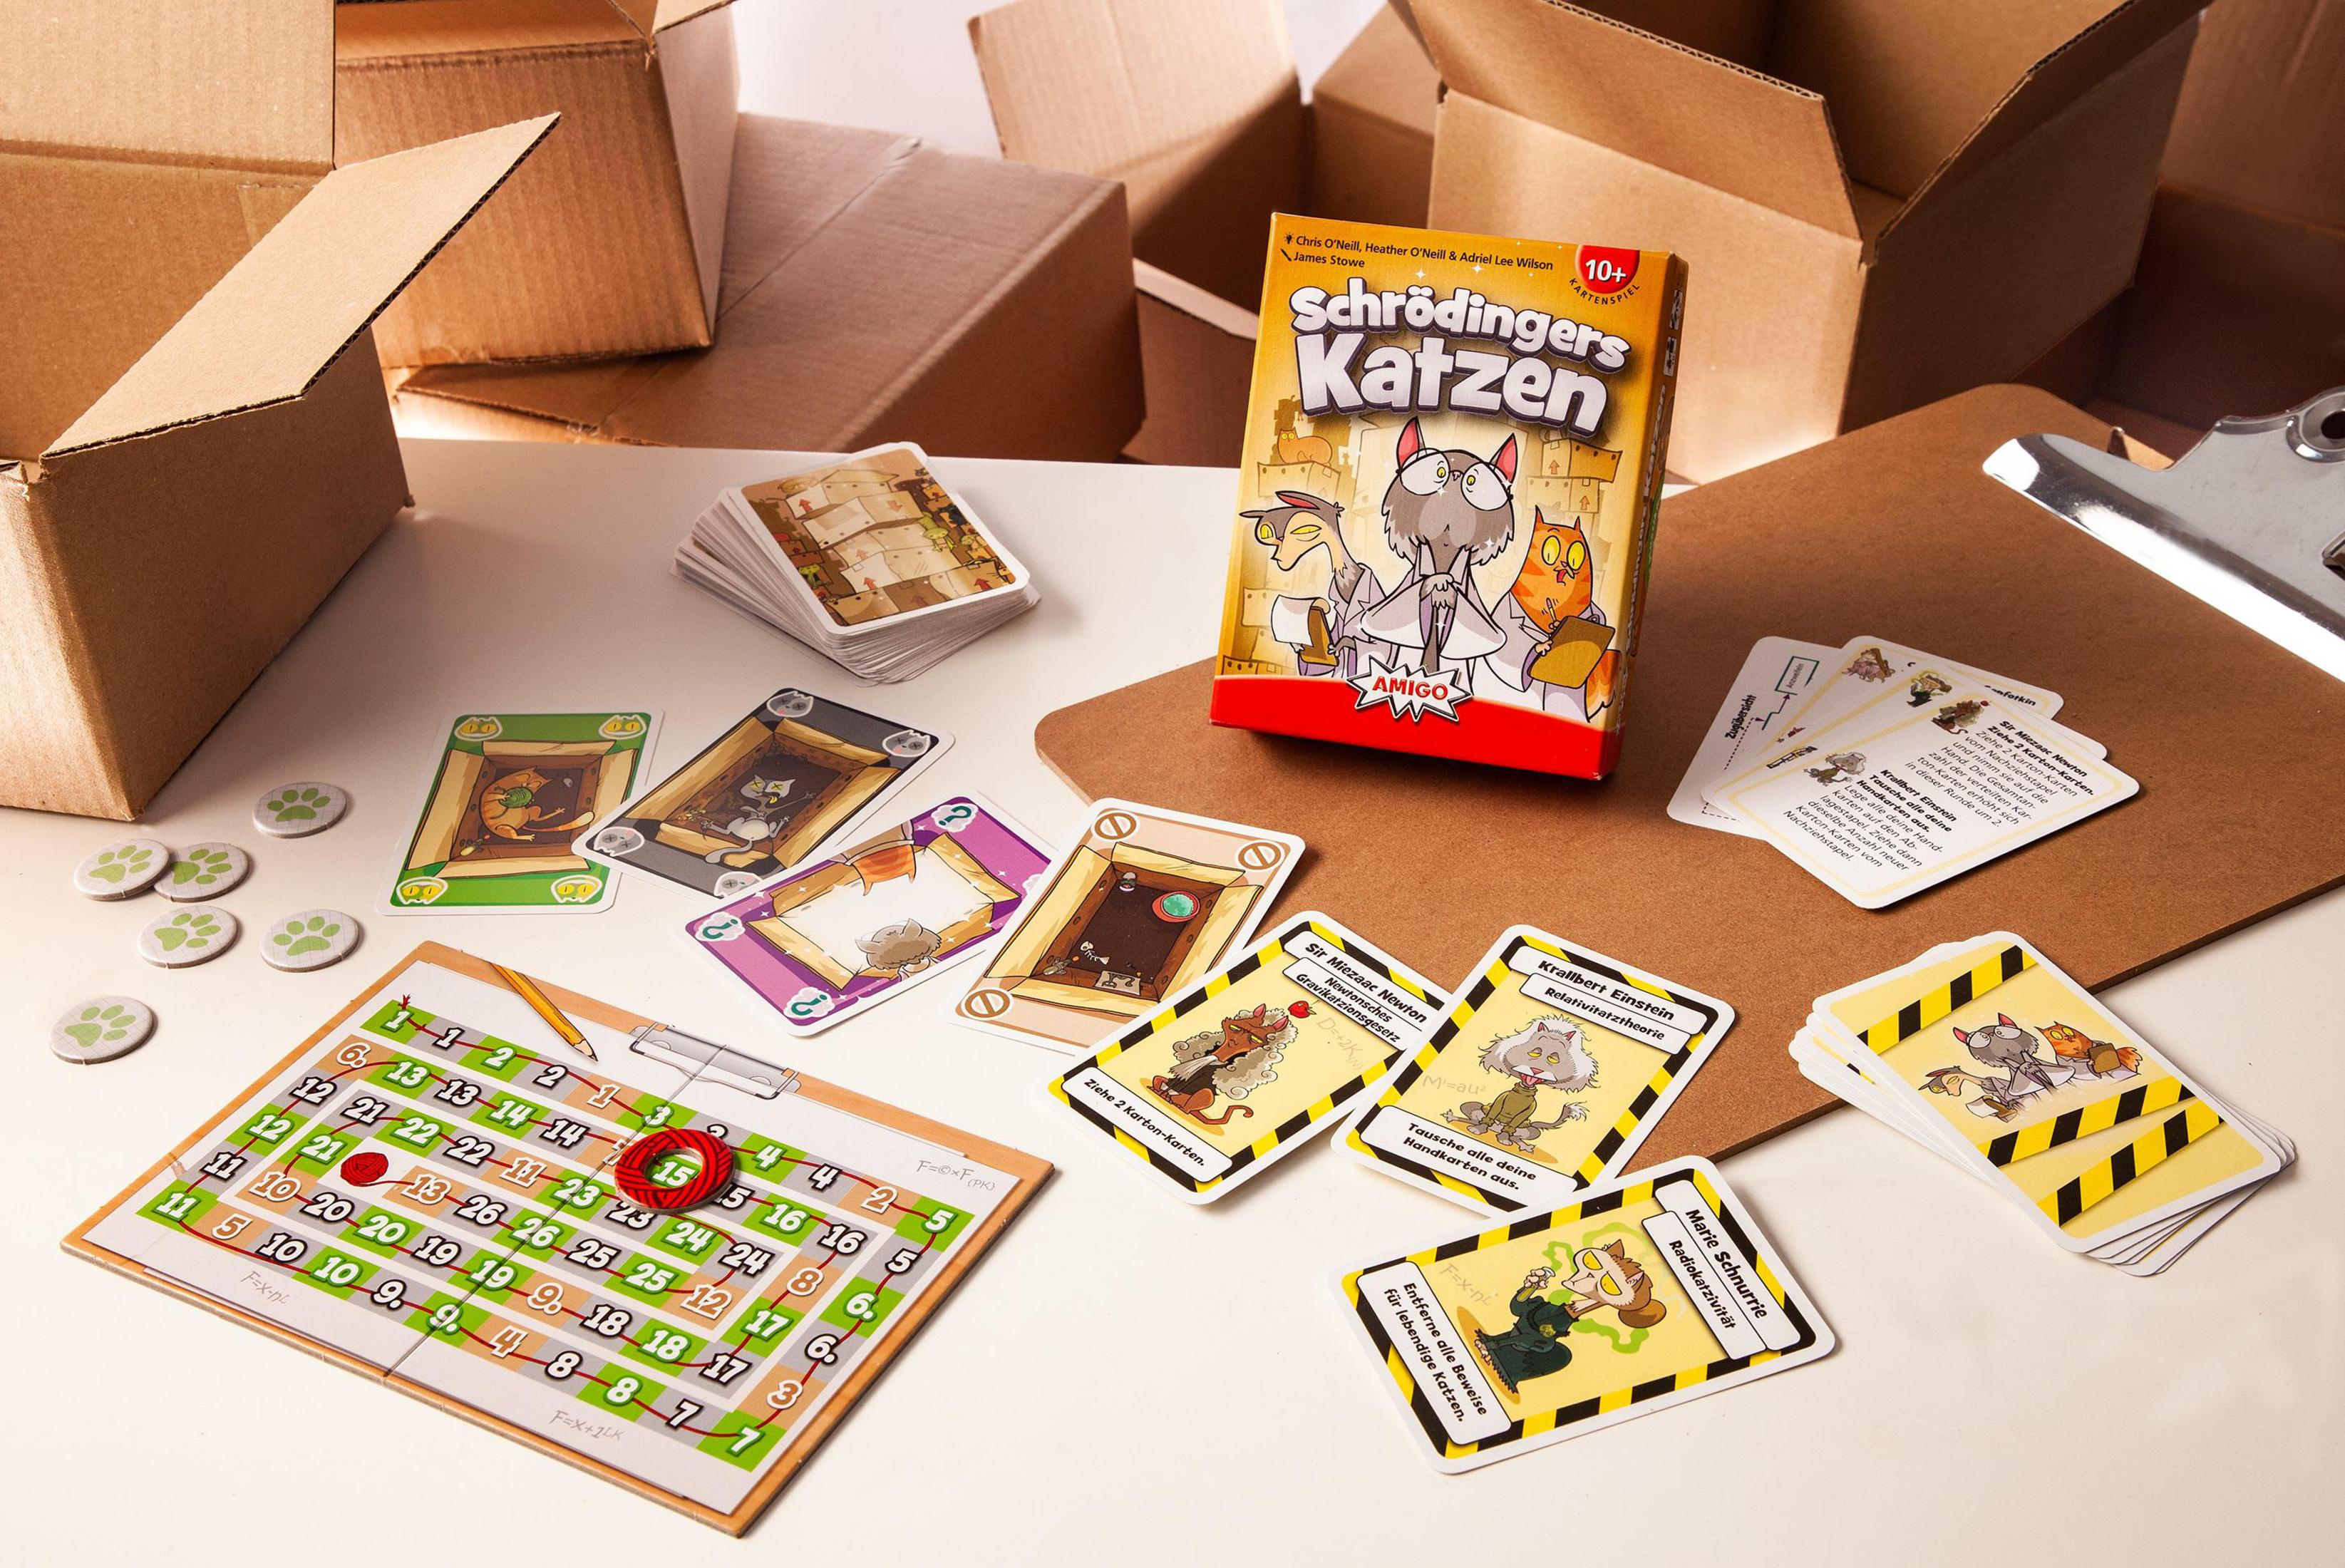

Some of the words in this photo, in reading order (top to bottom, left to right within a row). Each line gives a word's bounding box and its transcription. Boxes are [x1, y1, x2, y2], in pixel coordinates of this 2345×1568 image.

[1294, 252, 1326, 264] James
[1330, 255, 1365, 267] Stowe
[1296, 236, 1321, 247] Chris
[1366, 243, 1408, 256] Heather
[1449, 251, 1457, 261] &
[1459, 252, 1492, 264] Adriel
[1495, 255, 1513, 266] Lee
[1516, 258, 1553, 270] Wilson
[1585, 259, 1627, 283] 10+
[1569, 277, 1640, 304] KARTENSPIEL
[1289, 277, 1632, 375] Schrödingers
[1295, 333, 1609, 438] Katzen
[1372, 676, 1448, 701] AMIGO
[1724, 694, 1757, 739] Zugübersicht
[1941, 747, 1966, 765] Hand.
[1969, 765, 1986, 778] Die
[1987, 776, 2036, 810] Gesamtan-
[1953, 741, 1972, 755] und
[1974, 753, 1997, 769] nimm
[1998, 771, 2014, 783] sie
[2014, 780, 2031, 794] auf
[2031, 791, 2048, 805] die
[1965, 736, 1985, 749] vom
[1986, 751, 2057, 796] Nachziehstapel
[1976, 731, 2003, 748] Ziehe
[2011, 753, 2078, 797] Karton-Karten
[1988, 726, 2014, 743] Ziehe
[2022, 748, 2094, 795] Karton-Karten.
[1999, 721, 2016, 731] Sir
[2016, 729, 2052, 755] Miezaac
[2053, 754, 2087, 777] Newton
[1857, 780, 1911, 818] Handkarten
[1911, 817, 1930, 832] aus.
[1869, 775, 1906, 801] Tausche
[1906, 800, 1924, 815] alle
[1924, 813, 1952, 832] deine
[1880, 770, 1920, 797] Krallbert
[1919, 796, 1957, 822] Einstein
[1915, 768, 1944, 788] dieser
[1944, 788, 1974, 810] Runde
[1975, 808, 1991, 820] um
[1917, 757, 1967, 791] ton-Karten
[1967, 790, 1996, 813] erhöht
[1998, 811, 2019, 825] sich
[1928, 752, 1949, 767] zahl
[1949, 765, 1967, 778] der
[1967, 777, 2012, 808] verteilten
[2011, 806, 2032, 820] Kar-
[1783, 810, 1855, 862] Nachziehstapel.
[1795, 805, 1861, 852] Karton-Karten
[1861, 852, 1882, 867] vom
[1808, 800, 1846, 827] dieselbe
[1846, 827, 1881, 852] Anzahl
[1880, 850, 1910, 871] neuer
[1820, 795, 1867, 830] lagestapel.
[1869, 830, 1896, 850] Ziehe
[1897, 847, 1922, 867] dann
[1833, 790, 1863, 812] karten
[1863, 811, 1881, 824] auf
[1881, 824, 1900, 837] den
[1900, 837, 1918, 850] Ab-
[1845, 785, 1867, 802] Lege
[1867, 801, 1886, 815] alle
[1886, 813, 1913, 833] deine
[1913, 832, 1942, 853] Hand-
[1297, 974, 1401, 1042] Gravikatzionsgesetz
[1305, 943, 1327, 957] Sir
[1326, 956, 1378, 992] Miezaac
[1378, 989, 1428, 1023] Newton
[1325, 977, 1393, 1022] Newtonsches
[1537, 961, 1607, 994] Krallbert
[1610, 989, 1674, 1021] Einstein
[1545, 987, 1665, 1041] Relativitatztheorie
[383, 1010, 412, 1031] 1
[433, 1028, 463, 1048] 1
[482, 1046, 515, 1068] 2
[534, 1066, 567, 1088] 2
[588, 1085, 619, 1108] 1
[644, 1105, 672, 1127] 3
[755, 1144, 785, 1170] 4
[810, 1165, 840, 1190] 4
[862, 1187, 897, 1213] 2
[923, 1208, 957, 1232] 5
[1084, 1079, 1115, 1101] Ziehe
[1123, 1105, 1205, 1166] Karton-Karten.
[1408, 1123, 1465, 1151] Tausche
[1467, 1148, 1493, 1162] alle
[1497, 1161, 1536, 1180] deine
[290, 1078, 336, 1105] 12
[341, 1098, 388, 1124] 21
[391, 1117, 440, 1146] 22
[444, 1137, 493, 1166] 22
[501, 1158, 545, 1186] 11
[552, 1178, 602, 1207] 23
[664, 1221, 716, 1253] 24
[720, 1244, 773, 1275] 24
[788, 1268, 823, 1295] 8
[384, 1061, 429, 1087] 13
[436, 1080, 480, 1105] 13
[488, 1100, 535, 1128] 14
[542, 1119, 588, 1147] 14
[651, 1160, 696, 1187] 15
[762, 1203, 809, 1233] 16
[820, 1224, 866, 1254] 16
[886, 1249, 919, 1273] 5
[1403, 1137, 1488, 1176] Handkarten
[1490, 1175, 1519, 1190] aus.
[247, 1114, 293, 1142] 12
[299, 1135, 346, 1162] 21
[403, 1175, 450, 1203] 13
[455, 1196, 507, 1224] 26
[510, 1218, 562, 1247] 26
[567, 1240, 619, 1268] 25
[624, 1263, 676, 1292] 25
[682, 1285, 731, 1318] 12
[743, 1309, 791, 1340] 17
[202, 1152, 246, 1180] 11
[251, 1172, 299, 1200] 10
[302, 1192, 354, 1222] 20
[356, 1215, 408, 1244] 20
[413, 1237, 460, 1264] 19
[469, 1259, 516, 1289] 19
[581, 1305, 631, 1336] 18
[639, 1330, 690, 1361] 18
[701, 1354, 750, 1384] 17
[768, 1381, 802, 1408] 3
[1669, 1240, 1736, 1329] Radiokatzivität
[1686, 1209, 1718, 1248] Marie
[1714, 1252, 1767, 1319] Schnurrie
[153, 1192, 200, 1220] 11
[213, 1214, 251, 1239] 5
[257, 1234, 306, 1261] 10
[311, 1256, 361, 1285] 10
[490, 1326, 527, 1357] 4
[546, 1351, 582, 1378] 8
[605, 1377, 641, 1404] 8
[667, 1400, 701, 1428] 7
[729, 1427, 763, 1455] 7
[1384, 1289, 1402, 1307] für
[1396, 1310, 1436, 1370] lebendige
[1433, 1372, 1465, 1421] Katzen.
[1404, 1283, 1440, 1338] Entferne
[1437, 1340, 1455, 1363] alle
[1452, 1364, 1487, 1415] Beweise
